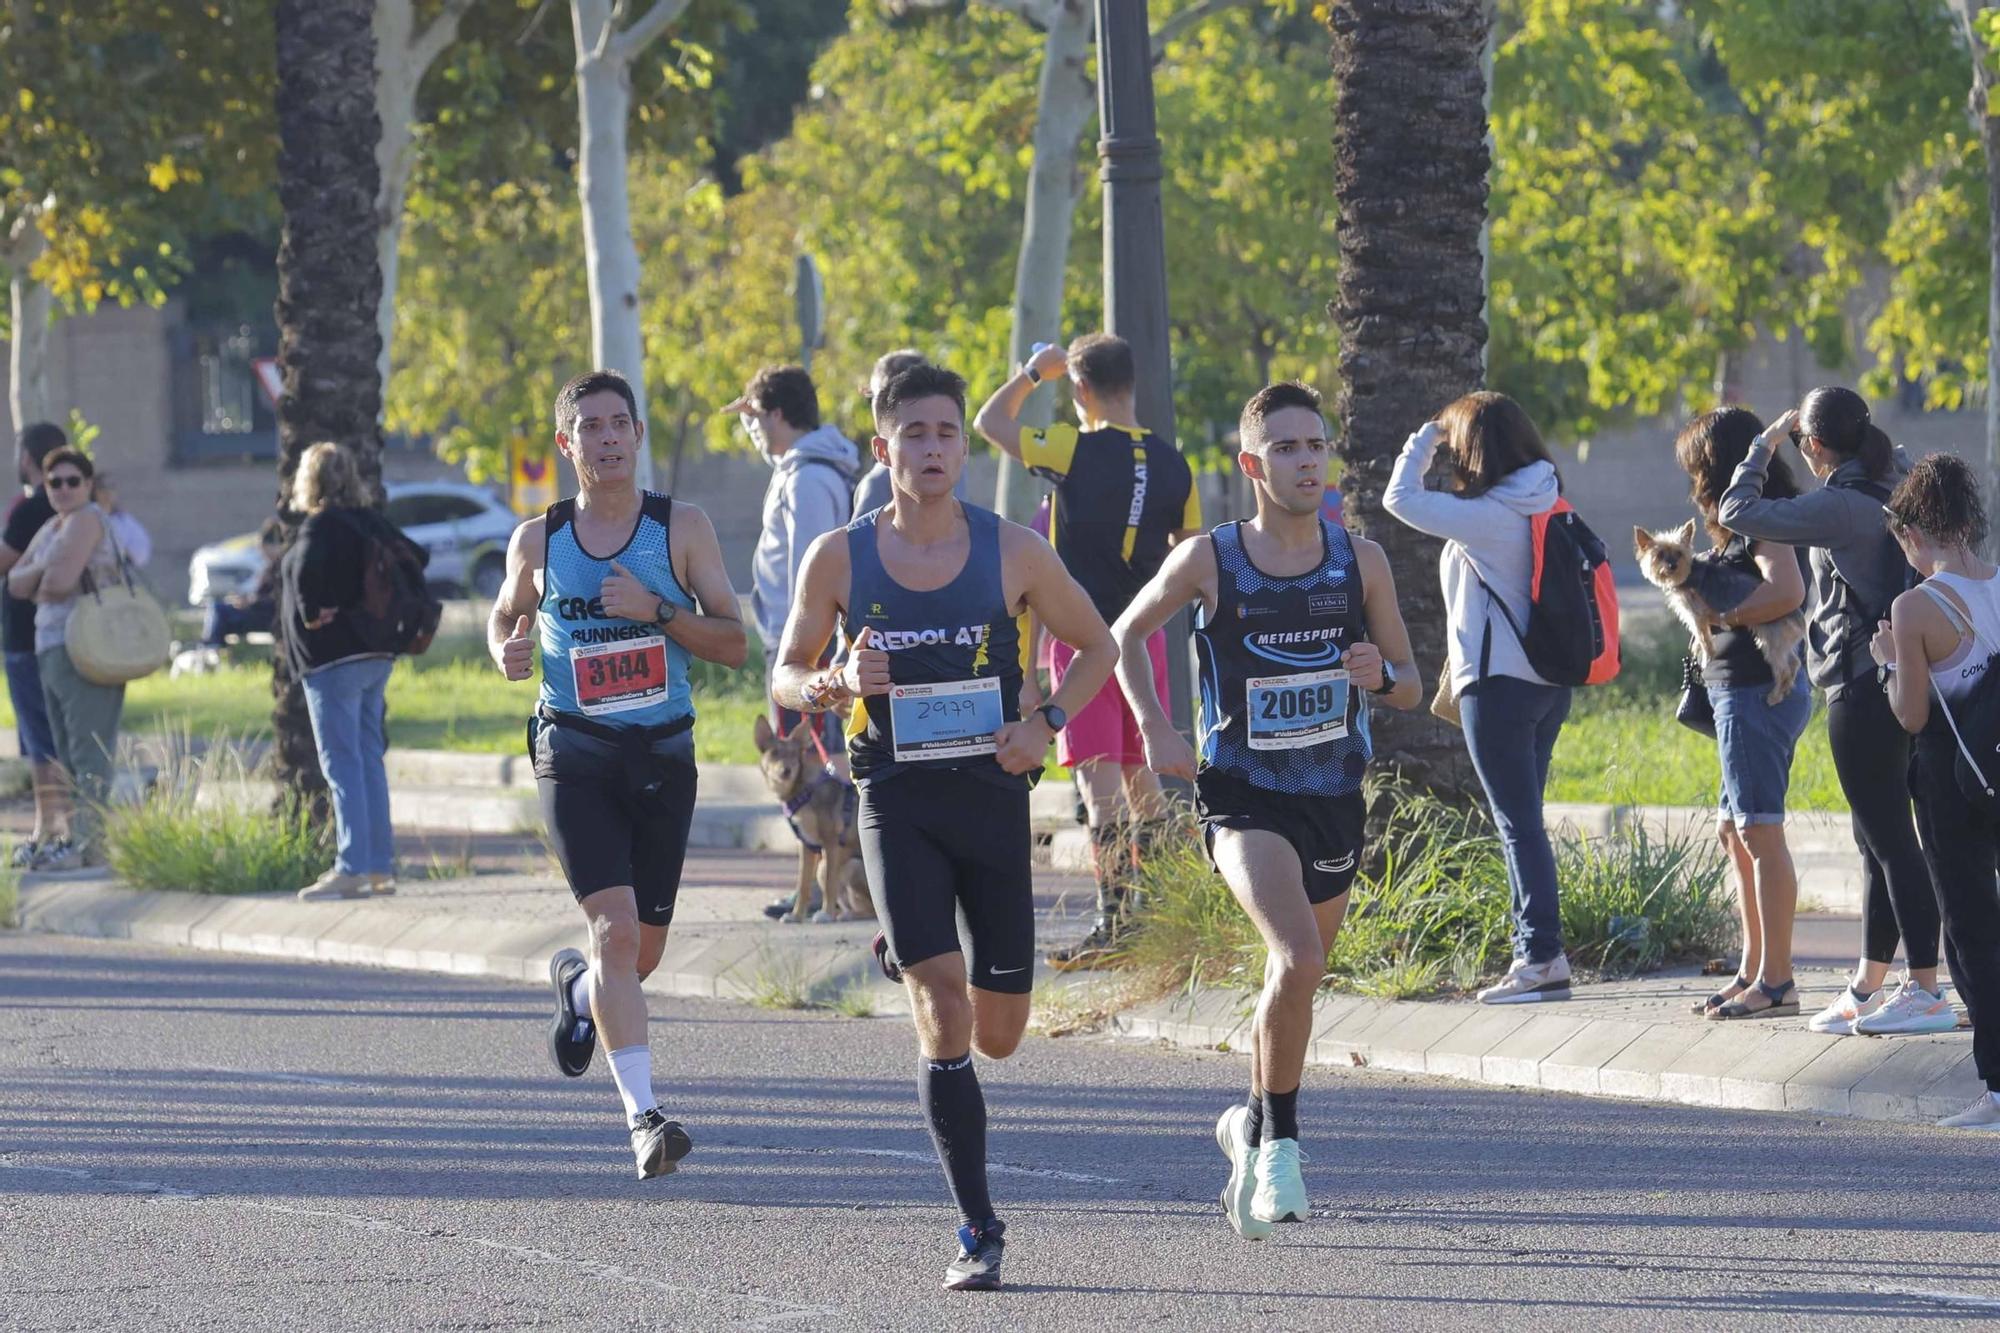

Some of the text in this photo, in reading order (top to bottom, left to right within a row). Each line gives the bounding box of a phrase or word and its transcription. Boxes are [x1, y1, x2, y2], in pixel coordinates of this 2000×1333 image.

[558, 596, 617, 621] CRE
[571, 624, 650, 643] RUNNERS
[1257, 627, 1344, 645] METAESPORT
[588, 651, 650, 687] 3144
[917, 699, 976, 720] 2979
[1260, 684, 1334, 720] 2069
